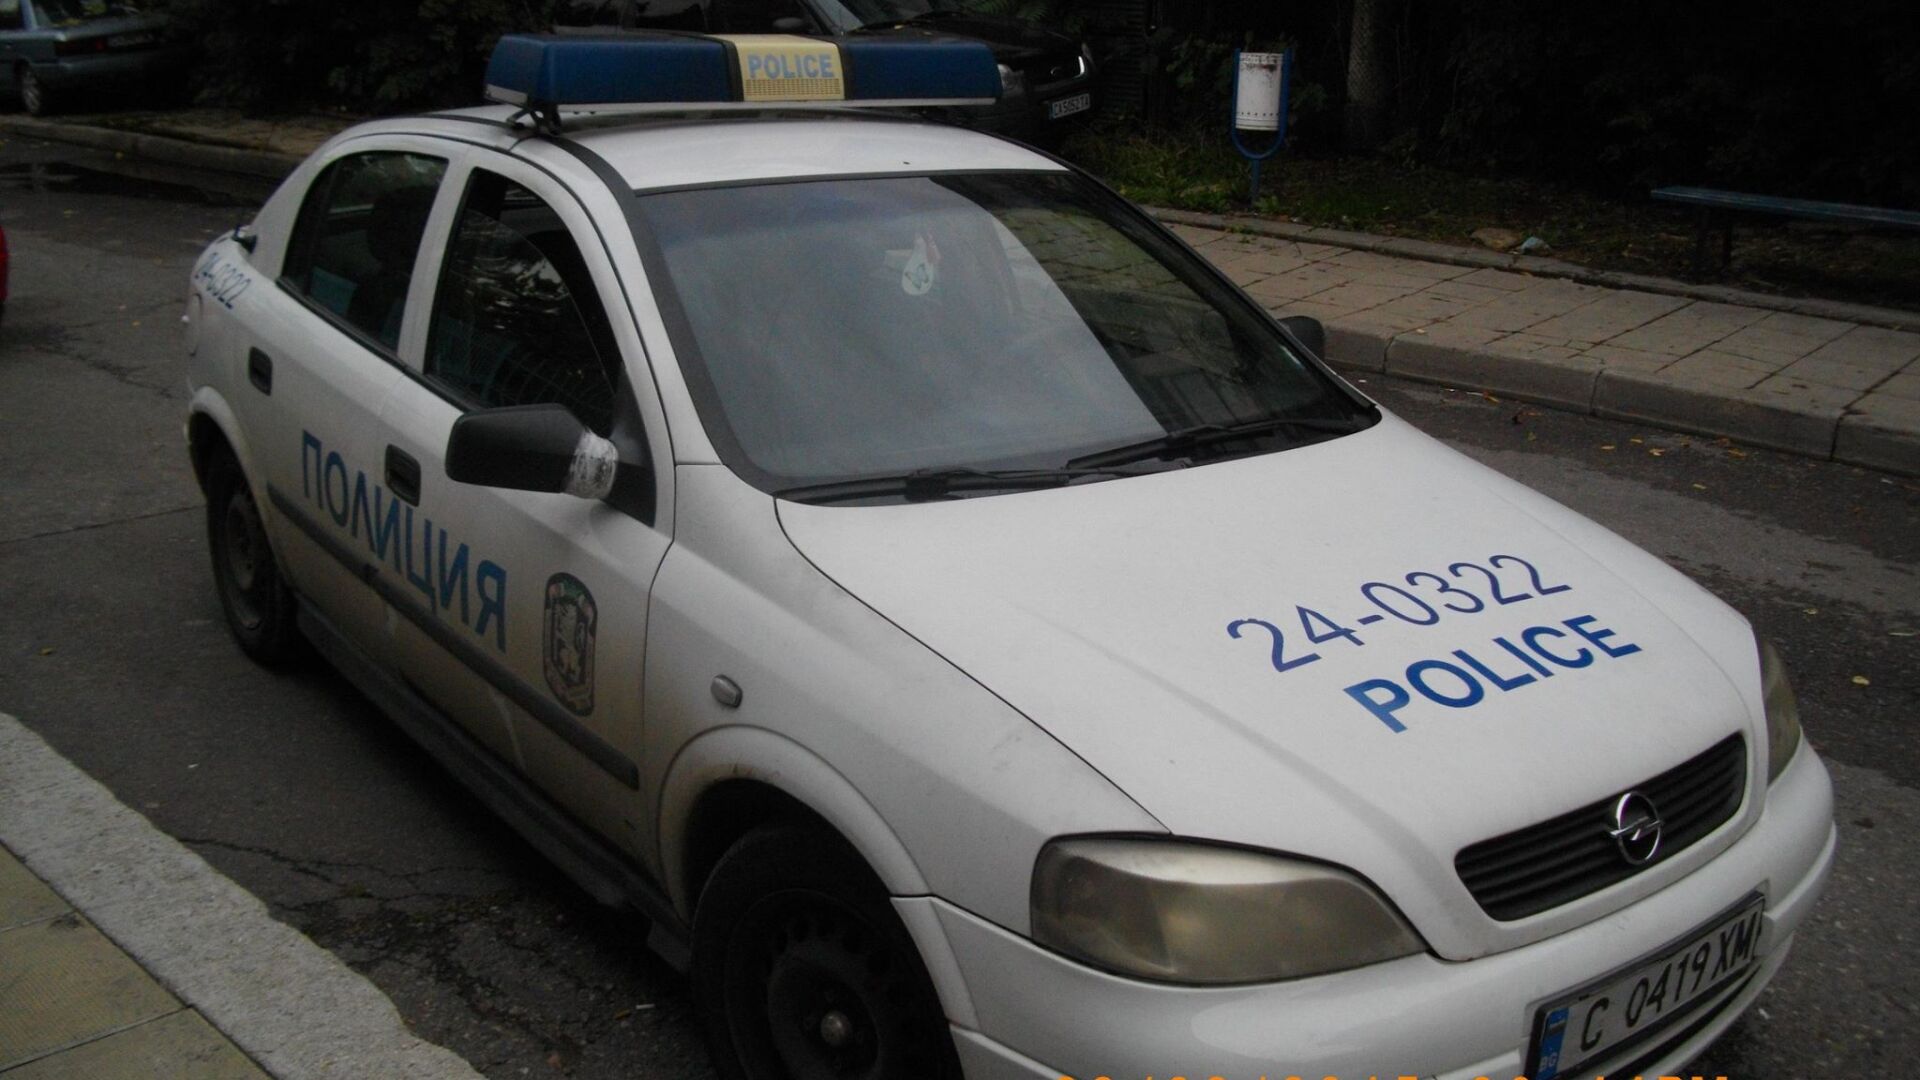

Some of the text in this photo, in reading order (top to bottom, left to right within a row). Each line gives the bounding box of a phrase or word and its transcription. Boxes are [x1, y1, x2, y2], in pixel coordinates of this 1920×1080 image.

[747, 53, 834, 79] POLICE
[194, 251, 251, 310] 24-0322
[302, 430, 507, 654] ПОЛИЦИЯ
[1227, 554, 1572, 673] 24-0322
[1342, 614, 1643, 735] POLICE
